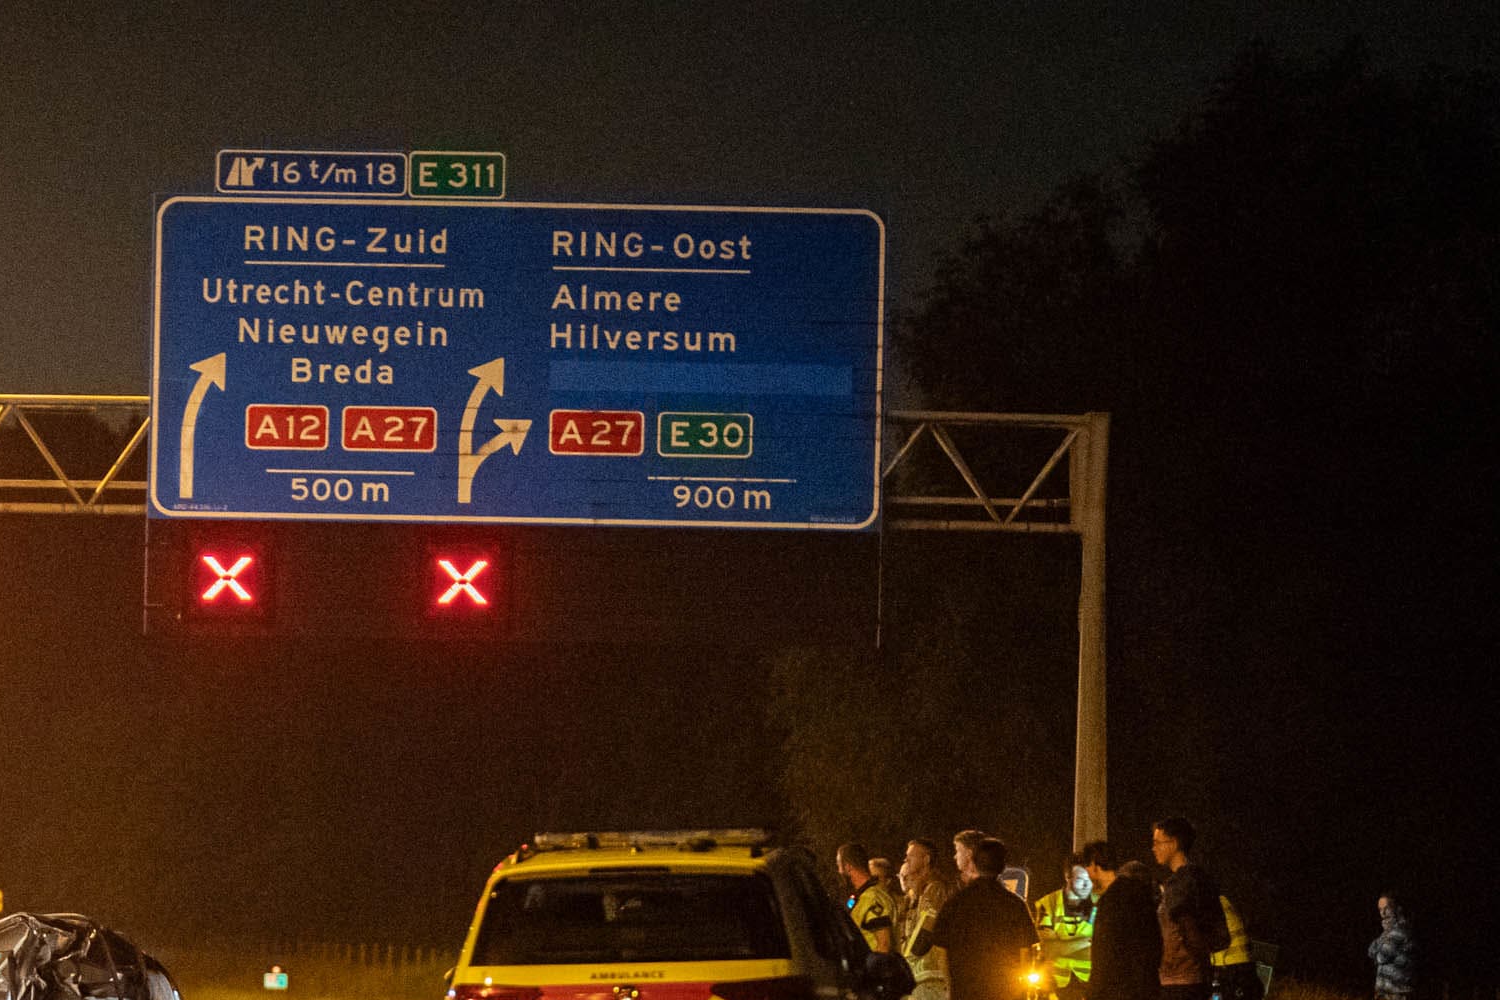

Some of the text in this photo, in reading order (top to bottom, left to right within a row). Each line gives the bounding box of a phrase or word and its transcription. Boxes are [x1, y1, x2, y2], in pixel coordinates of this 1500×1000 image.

[271, 158, 397, 186] 16 t/m 18
[419, 163, 497, 189] E 311
[243, 225, 449, 255] RING-Zuid
[551, 230, 752, 260] RING-Oost
[201, 277, 485, 309] Utrecht-Centrum
[550, 284, 682, 313] Almere
[237, 317, 449, 353] Nieuwegein
[550, 323, 737, 353] Hilversum
[290, 357, 395, 385] Breda
[254, 415, 321, 441] A12
[350, 416, 430, 443] A27
[558, 420, 636, 446] A27
[670, 421, 745, 449] E 30
[290, 478, 389, 502] 500 m
[672, 485, 772, 510] 900 m
[590, 971, 666, 980] AMBULANCE
